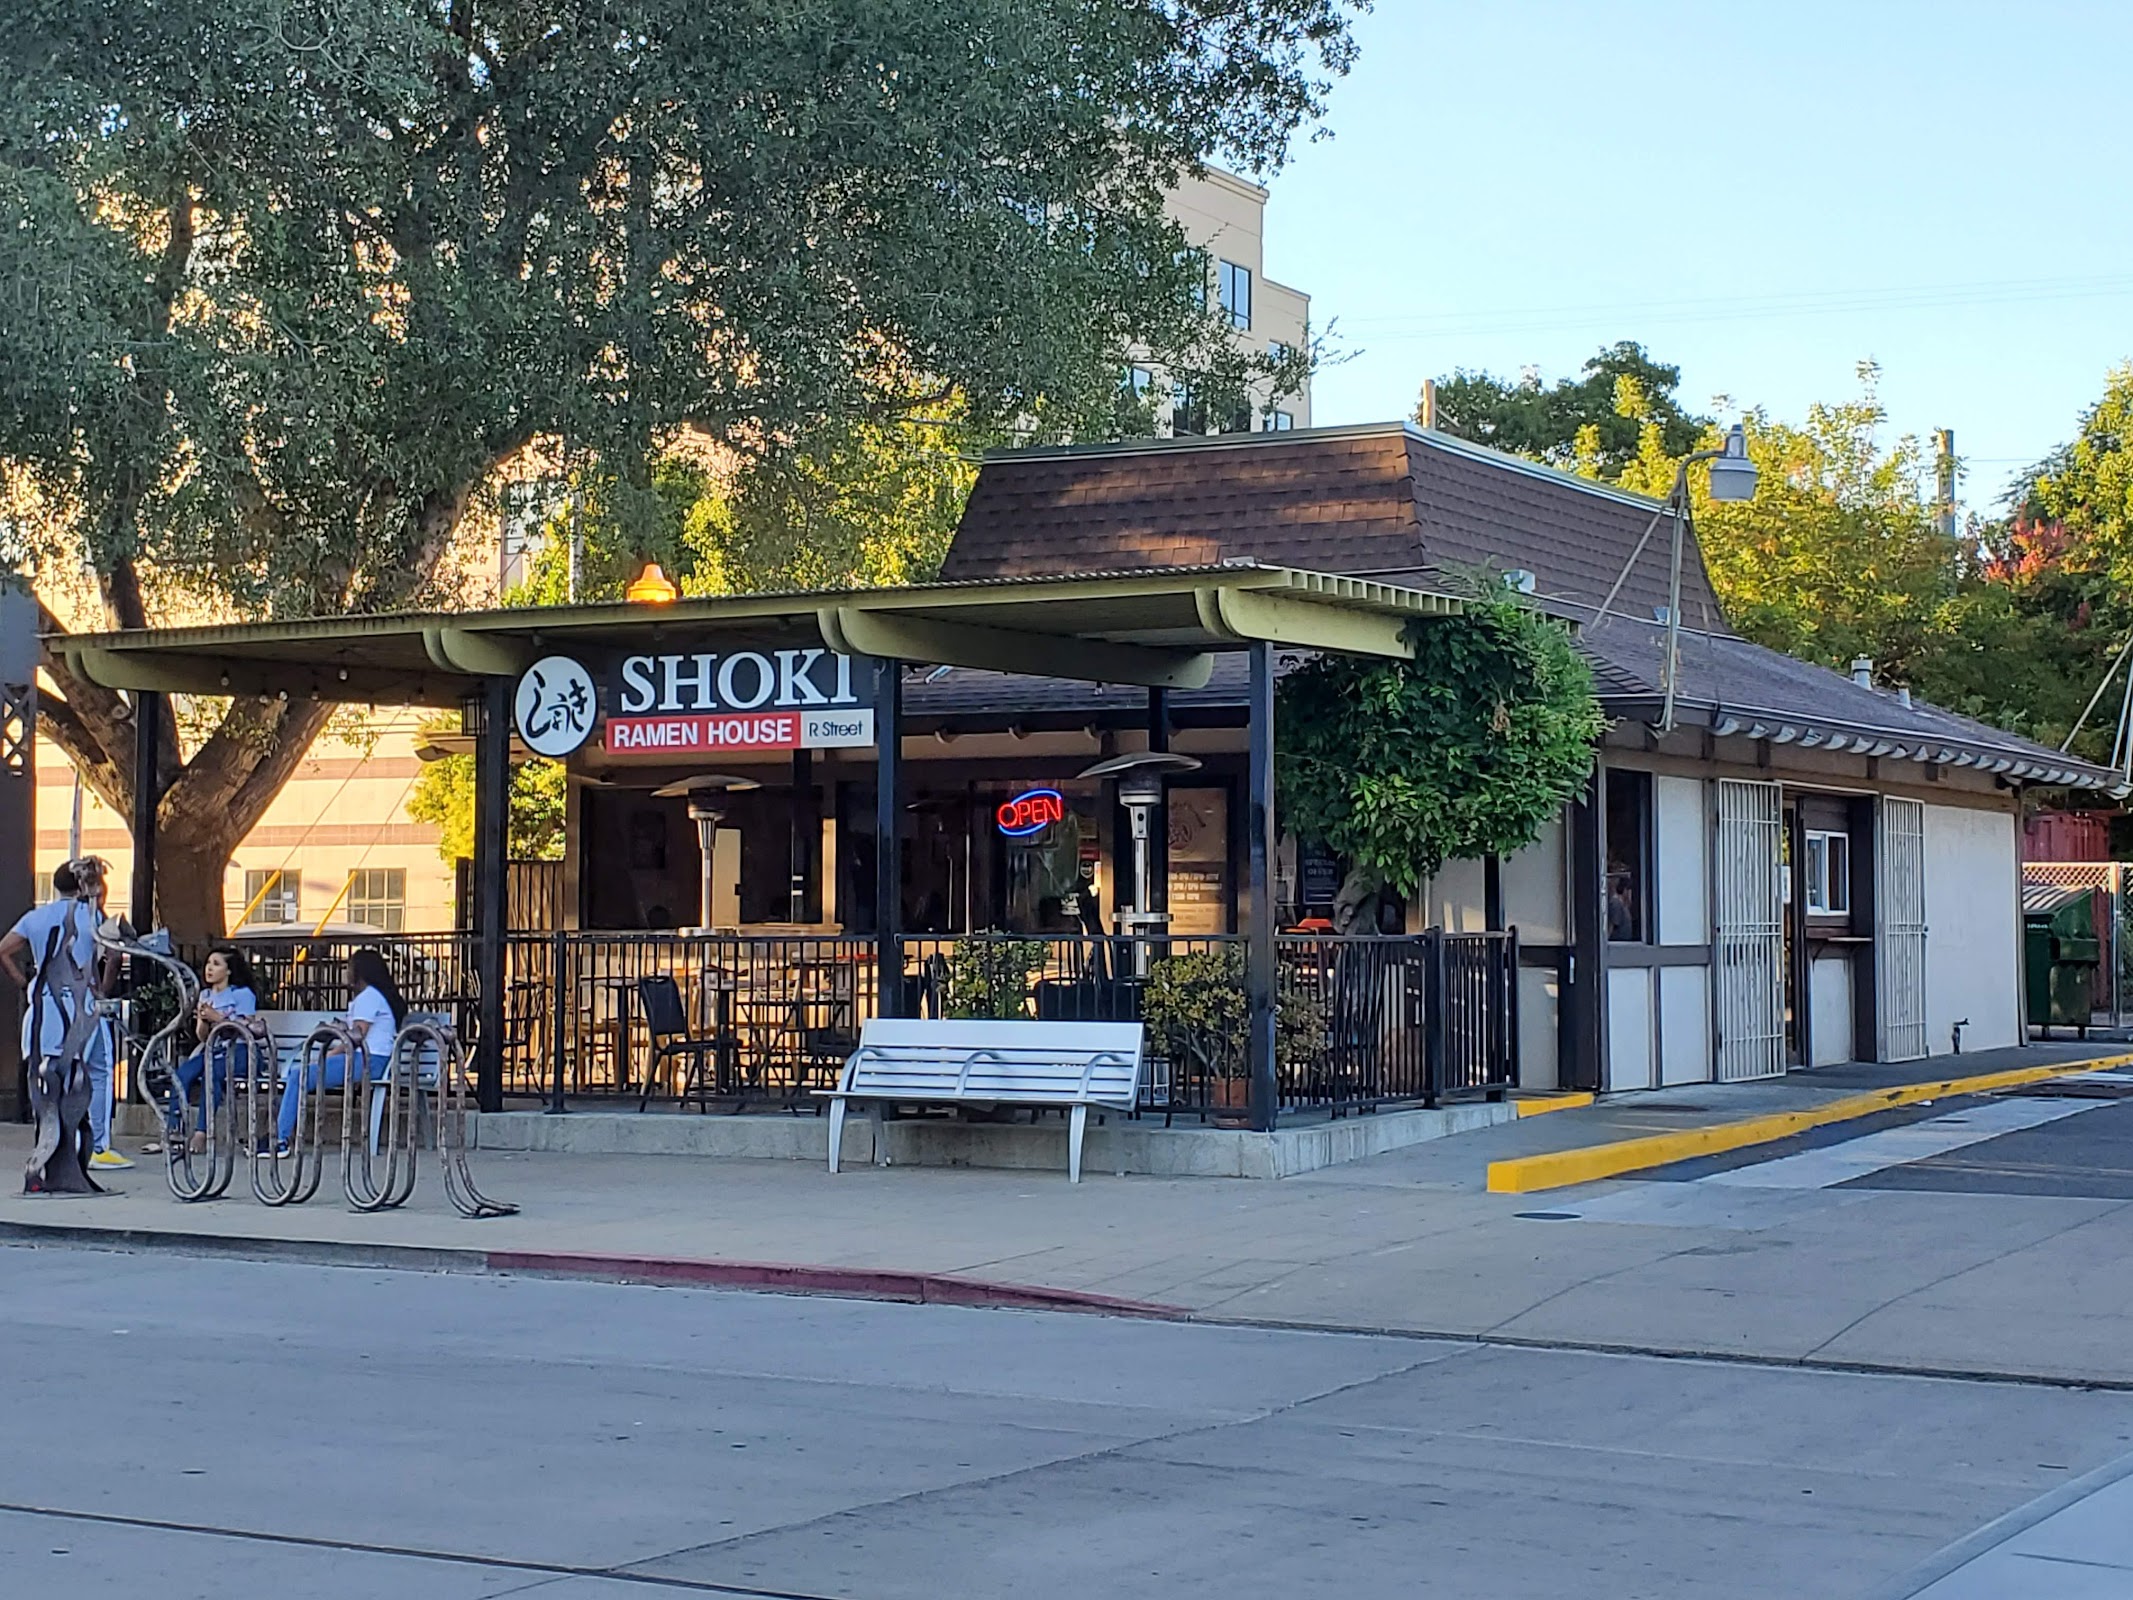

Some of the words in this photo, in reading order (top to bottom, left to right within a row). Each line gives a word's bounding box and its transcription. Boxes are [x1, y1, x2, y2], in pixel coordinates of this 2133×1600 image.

[621, 648, 858, 713] SHOKI
[614, 722, 698, 748] RAMEN
[708, 718, 793, 745] HOUSE
[809, 722, 819, 737] R
[822, 720, 863, 737] Street
[998, 797, 1062, 828] OPEN
